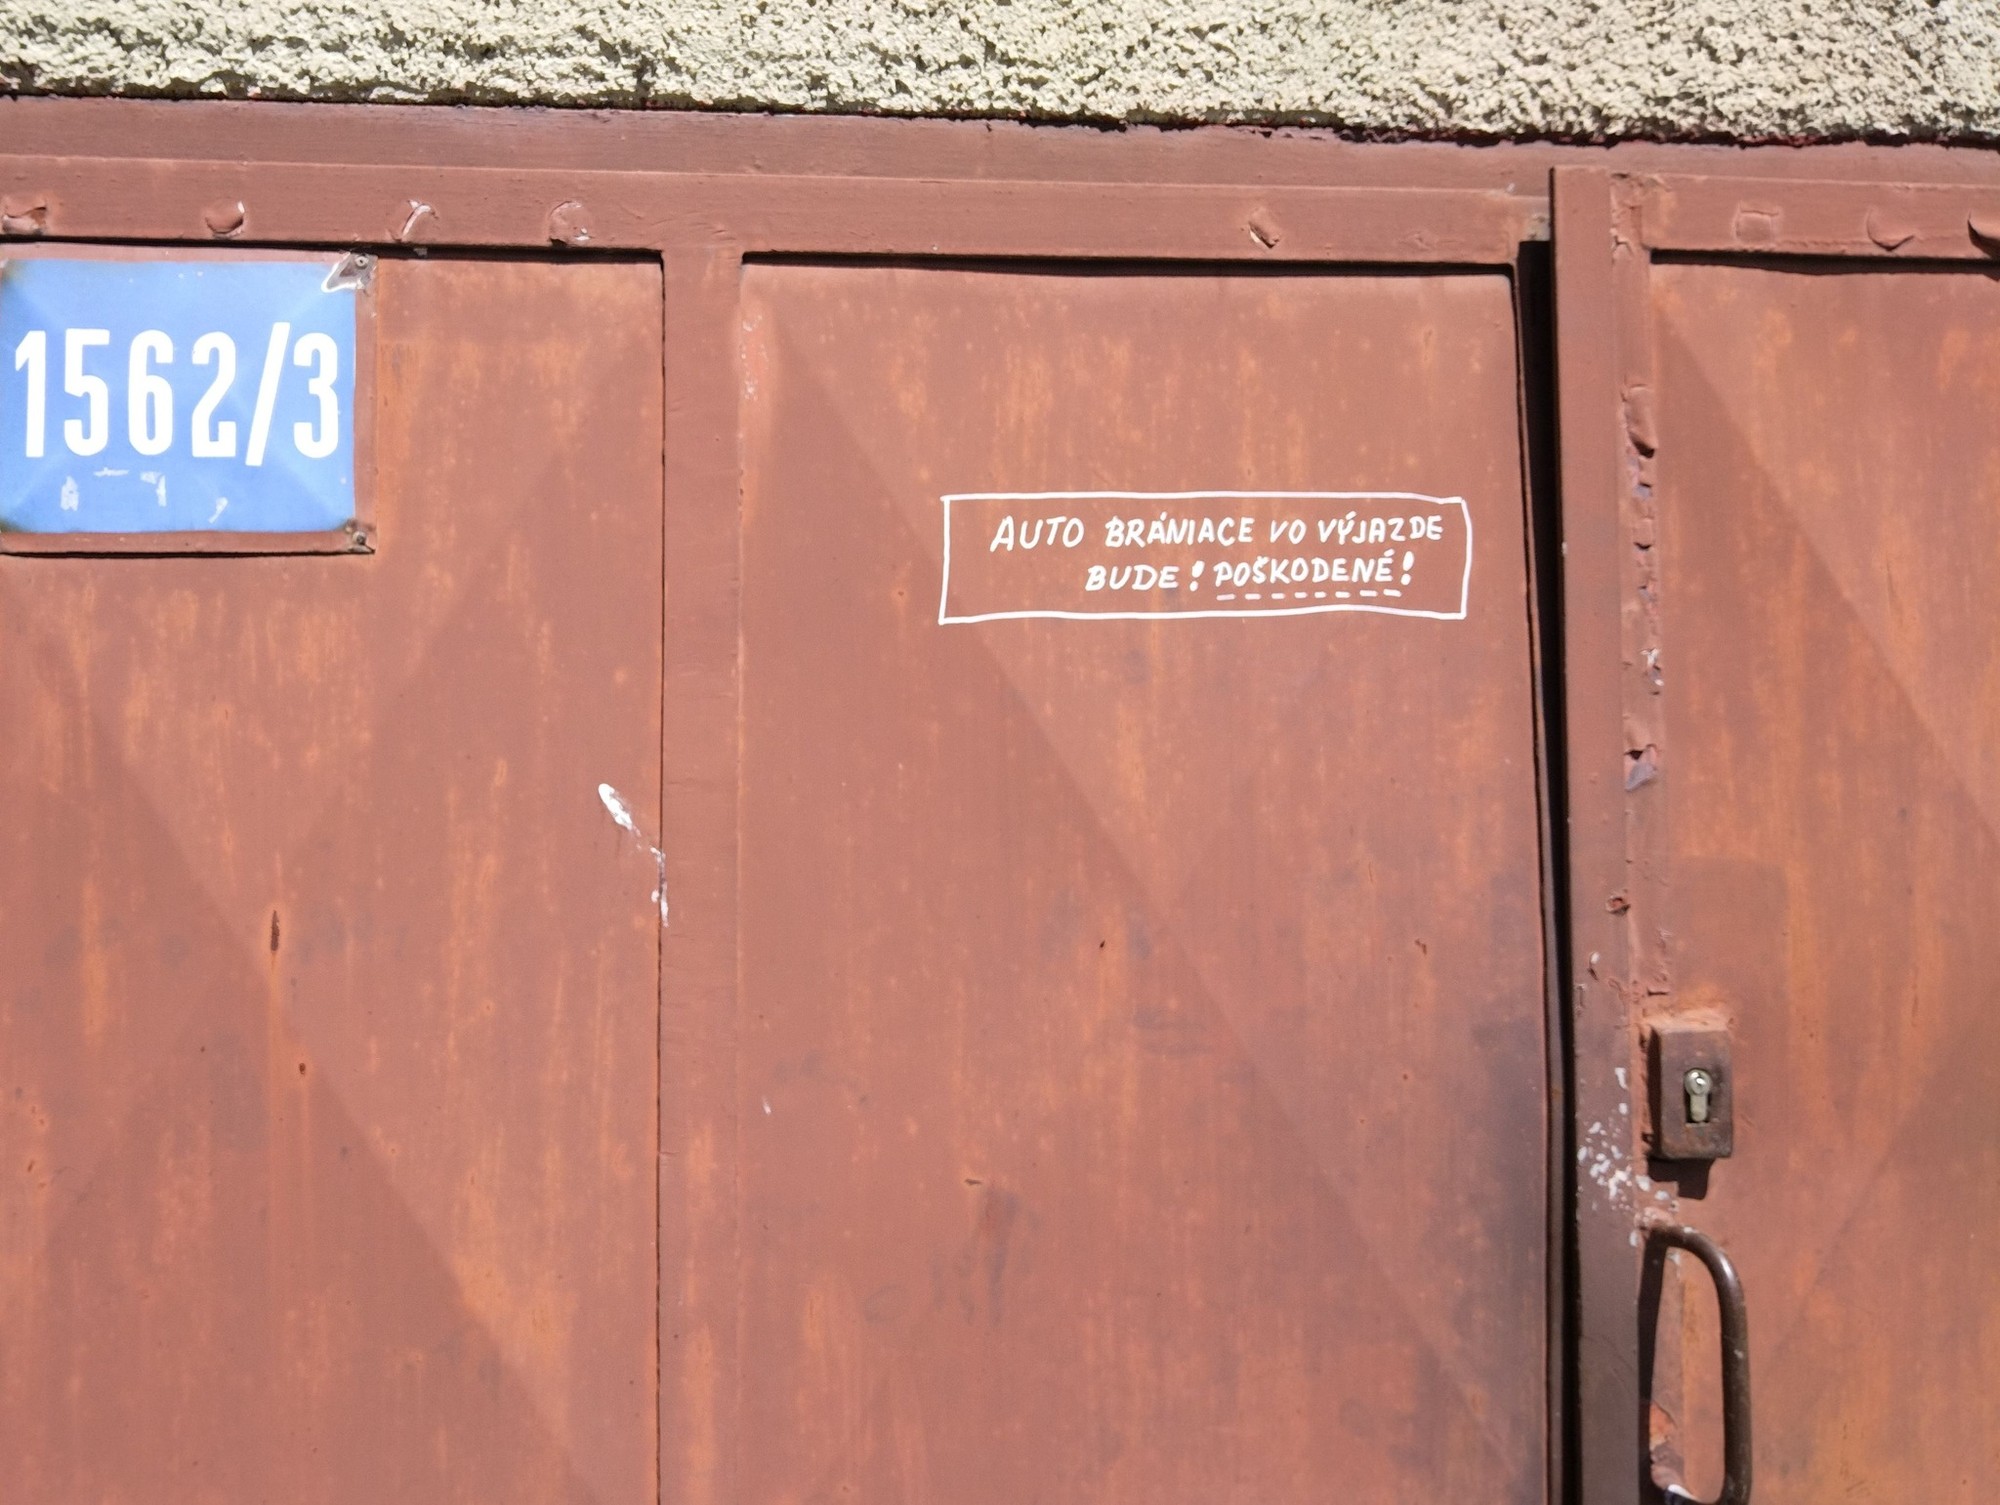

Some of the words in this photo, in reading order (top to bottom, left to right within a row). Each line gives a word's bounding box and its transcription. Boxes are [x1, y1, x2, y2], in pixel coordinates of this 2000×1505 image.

[14, 322, 340, 467] 1562/3
[989, 515, 1085, 553] AUTO
[1104, 511, 1255, 548] BRÁNIACE
[1269, 518, 1307, 545] VO
[1317, 511, 1444, 546] VÝJAZDE
